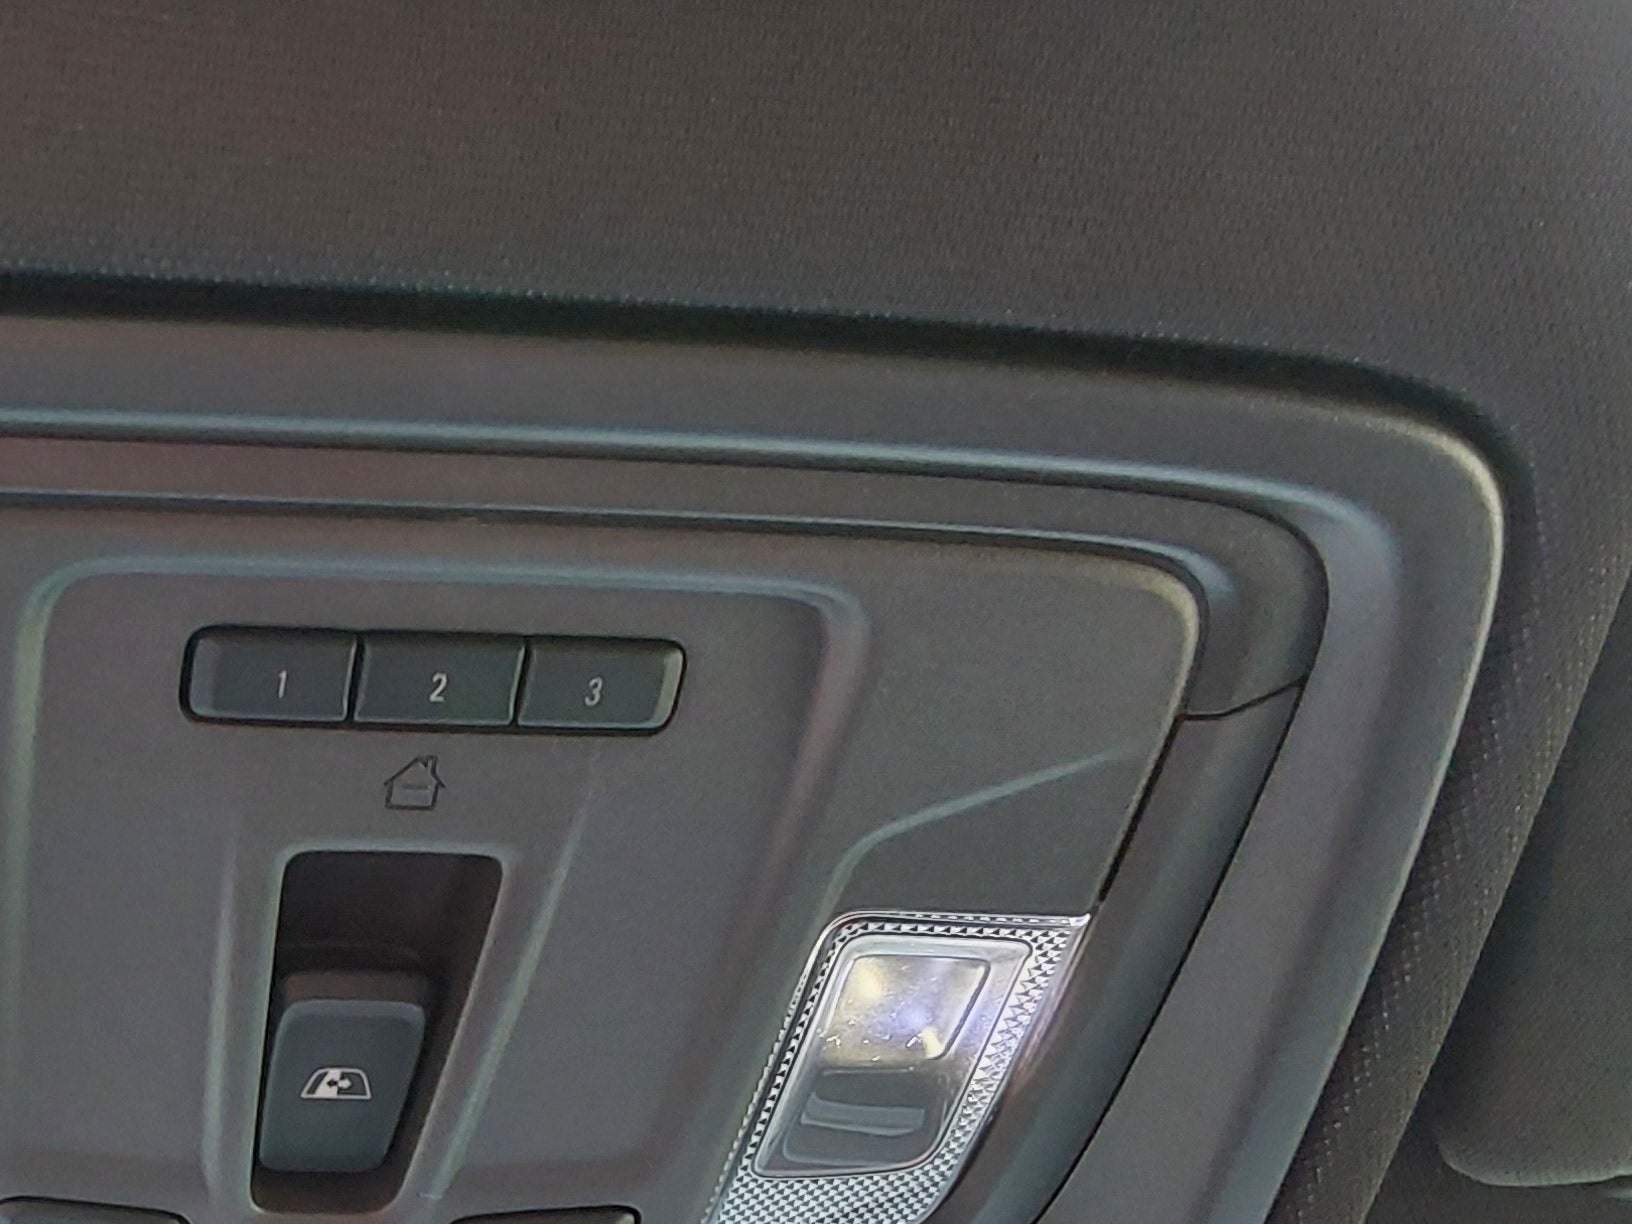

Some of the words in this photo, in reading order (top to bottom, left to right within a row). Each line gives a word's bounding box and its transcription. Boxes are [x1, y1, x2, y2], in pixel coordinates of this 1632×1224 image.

[276, 670, 289, 698] 1
[429, 672, 449, 702] 2
[584, 676, 604, 706] 3
